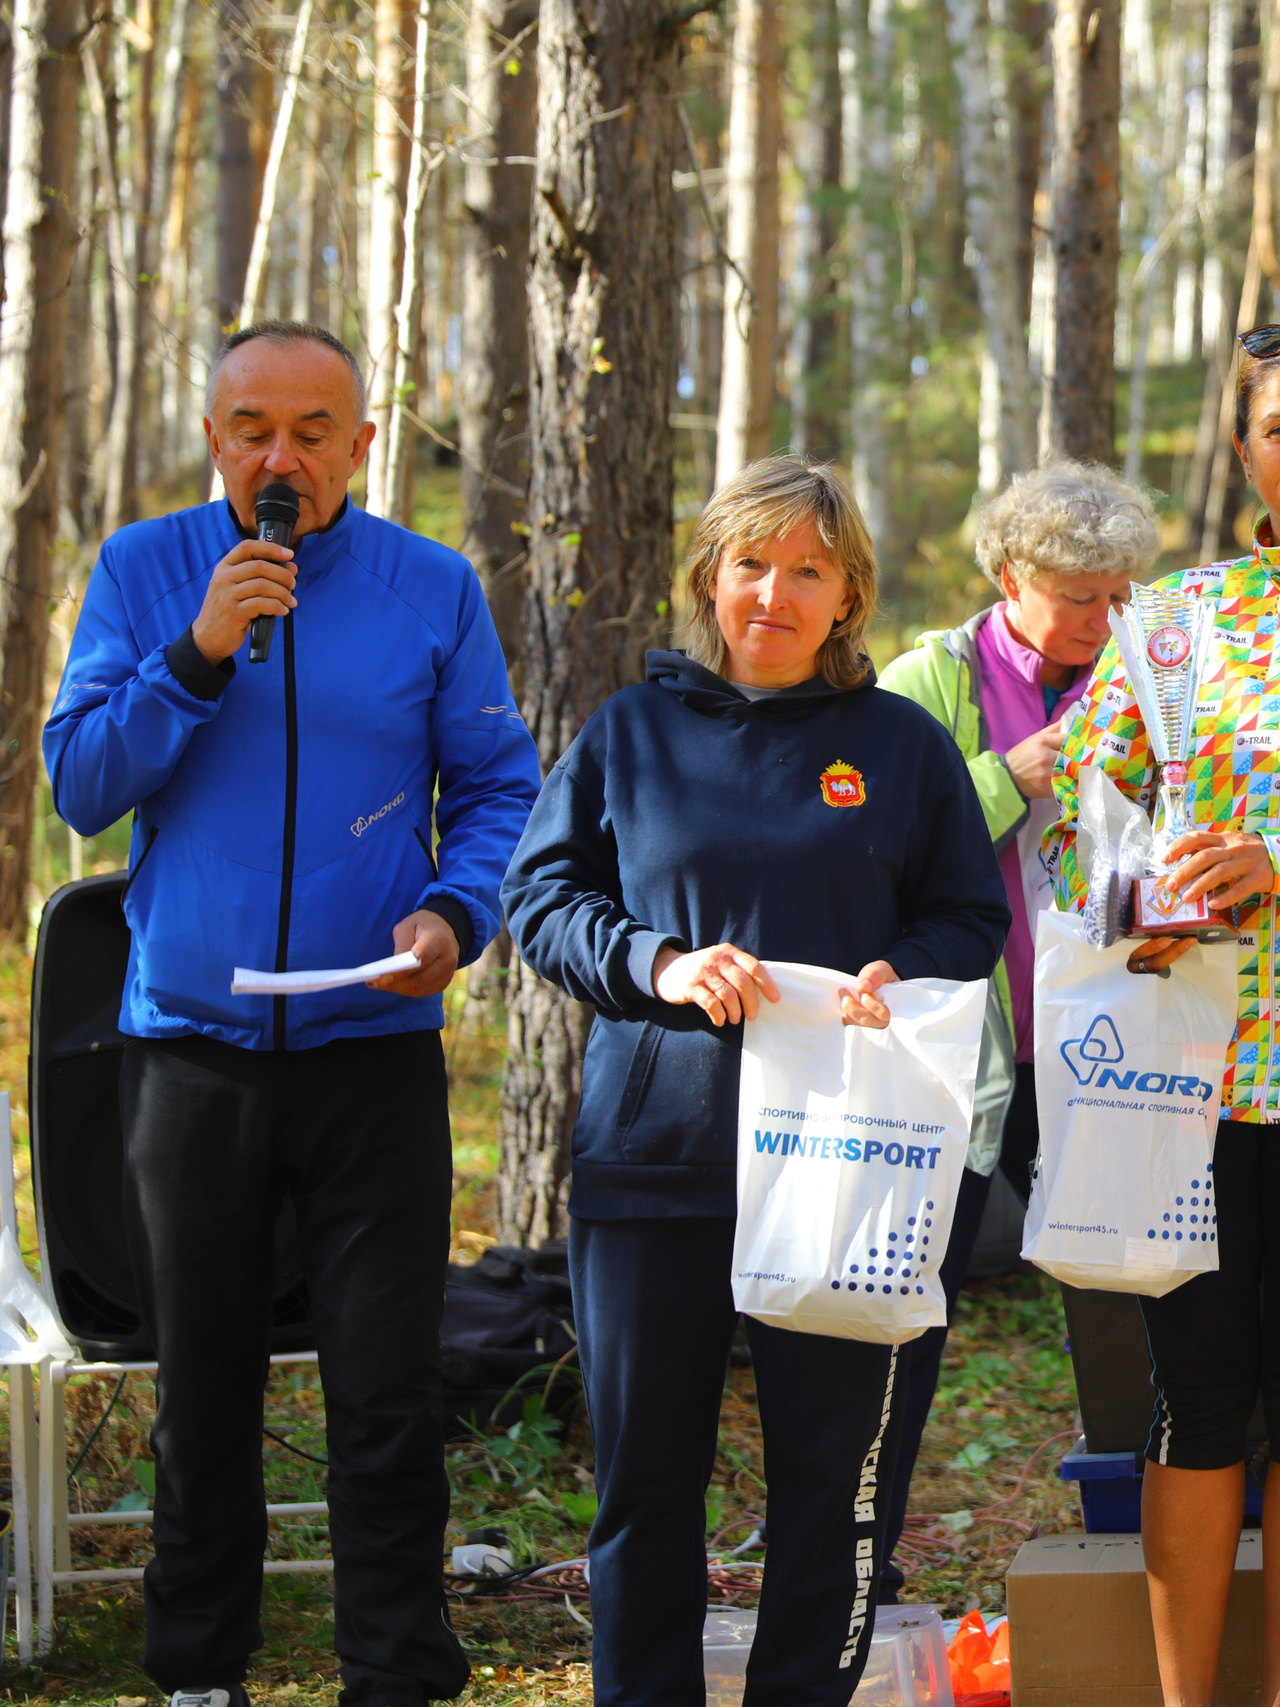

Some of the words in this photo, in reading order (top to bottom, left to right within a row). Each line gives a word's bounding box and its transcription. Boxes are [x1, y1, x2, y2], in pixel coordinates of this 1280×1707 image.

[368, 791, 405, 826] NORD
[1095, 1068, 1213, 1102] NORD
[754, 1130, 942, 1170] WINTERSPORT
[1048, 1221, 1118, 1235] wintersport45.ru
[839, 1537, 873, 1669] ОБЛАСТЬ
